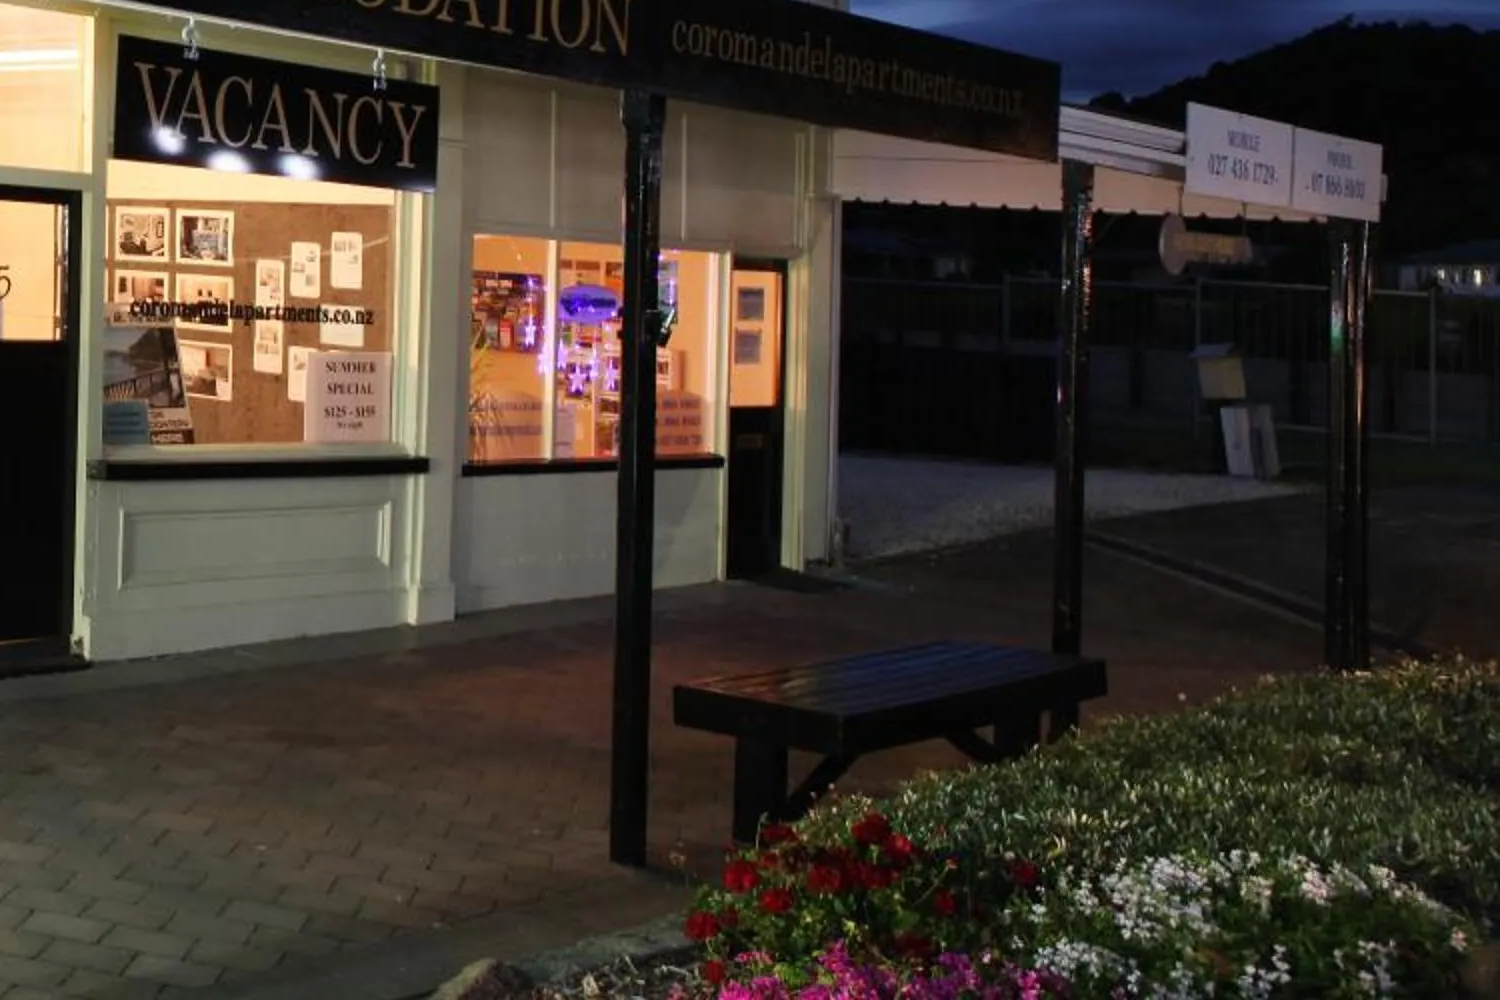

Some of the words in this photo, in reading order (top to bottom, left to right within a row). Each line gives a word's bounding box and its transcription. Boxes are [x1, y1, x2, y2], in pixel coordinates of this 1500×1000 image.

[134, 61, 427, 169] VACANCY
[130, 297, 374, 326] coromandelapartments.co.nz
[325, 360, 376, 374] SUMMER
[327, 382, 375, 396] SPECIAL
